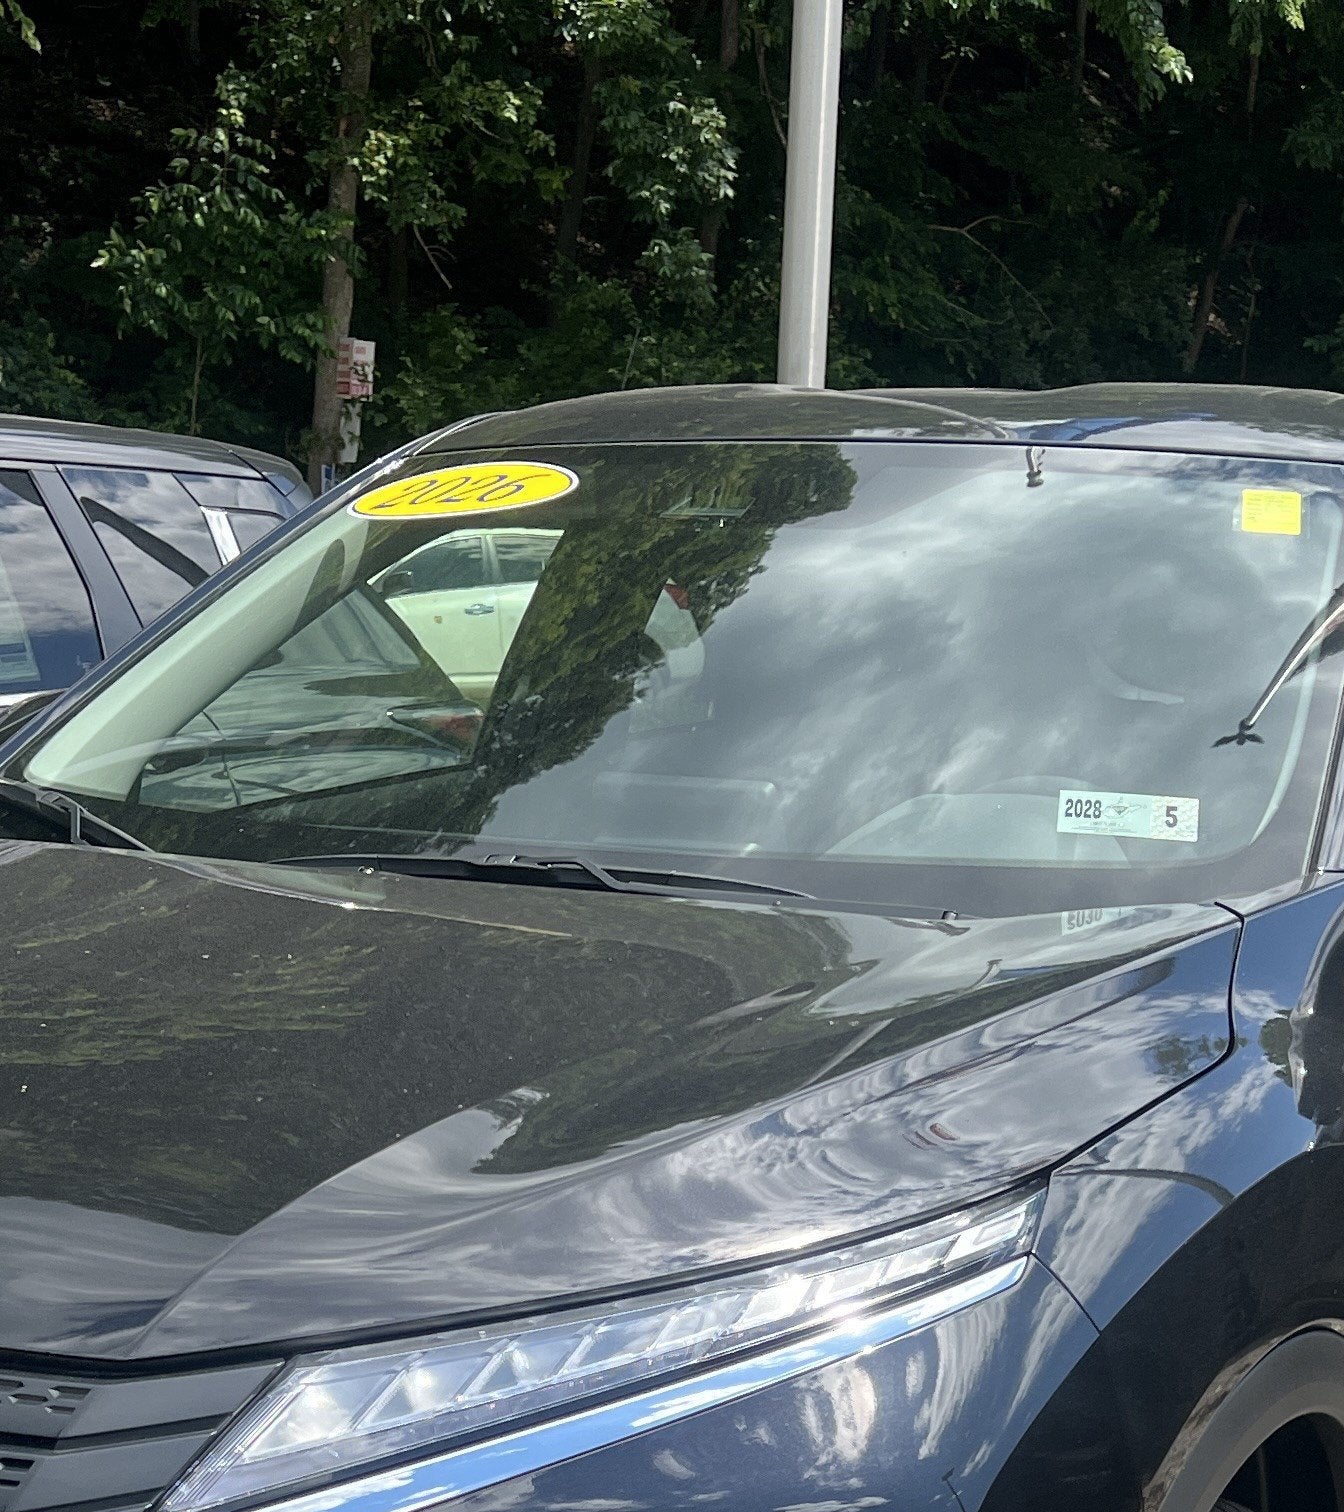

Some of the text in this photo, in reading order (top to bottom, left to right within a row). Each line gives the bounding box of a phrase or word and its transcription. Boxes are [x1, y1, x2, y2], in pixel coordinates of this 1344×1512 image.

[369, 473, 552, 509] 2026
[1064, 798, 1102, 819] 2028
[1164, 805, 1178, 828] 5
